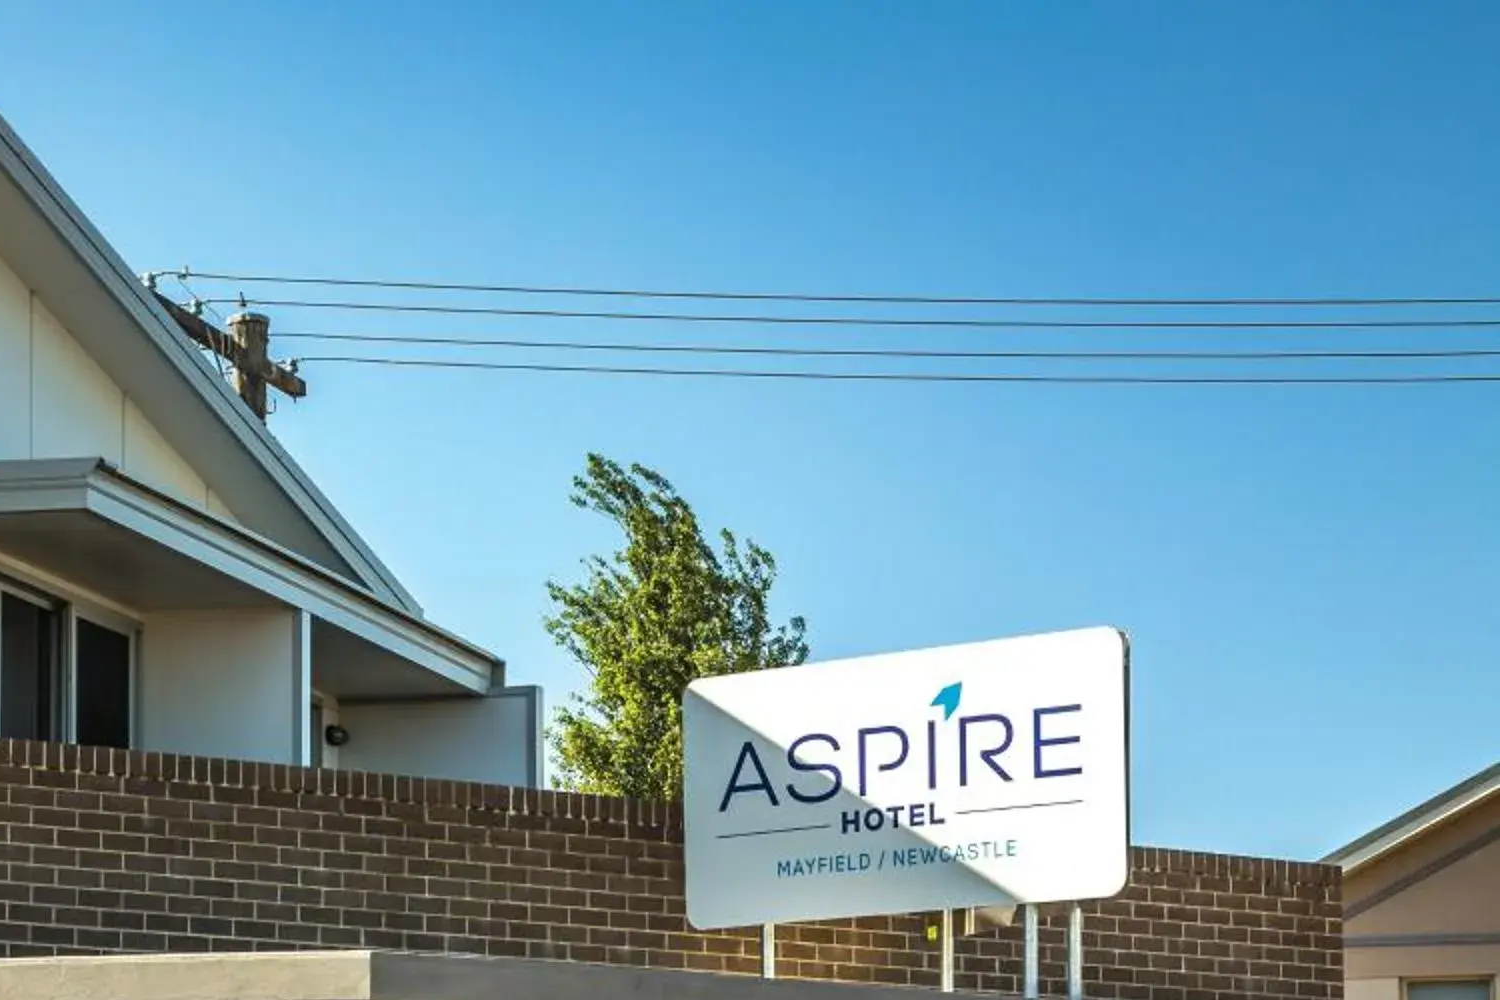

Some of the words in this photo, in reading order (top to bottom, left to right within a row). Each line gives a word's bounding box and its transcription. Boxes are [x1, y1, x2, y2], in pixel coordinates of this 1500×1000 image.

[719, 703, 1084, 813] ASPIRE
[841, 803, 946, 835] HOTEL
[776, 852, 871, 879] MAYFIELD
[893, 839, 1018, 868] NEWCASTLE
